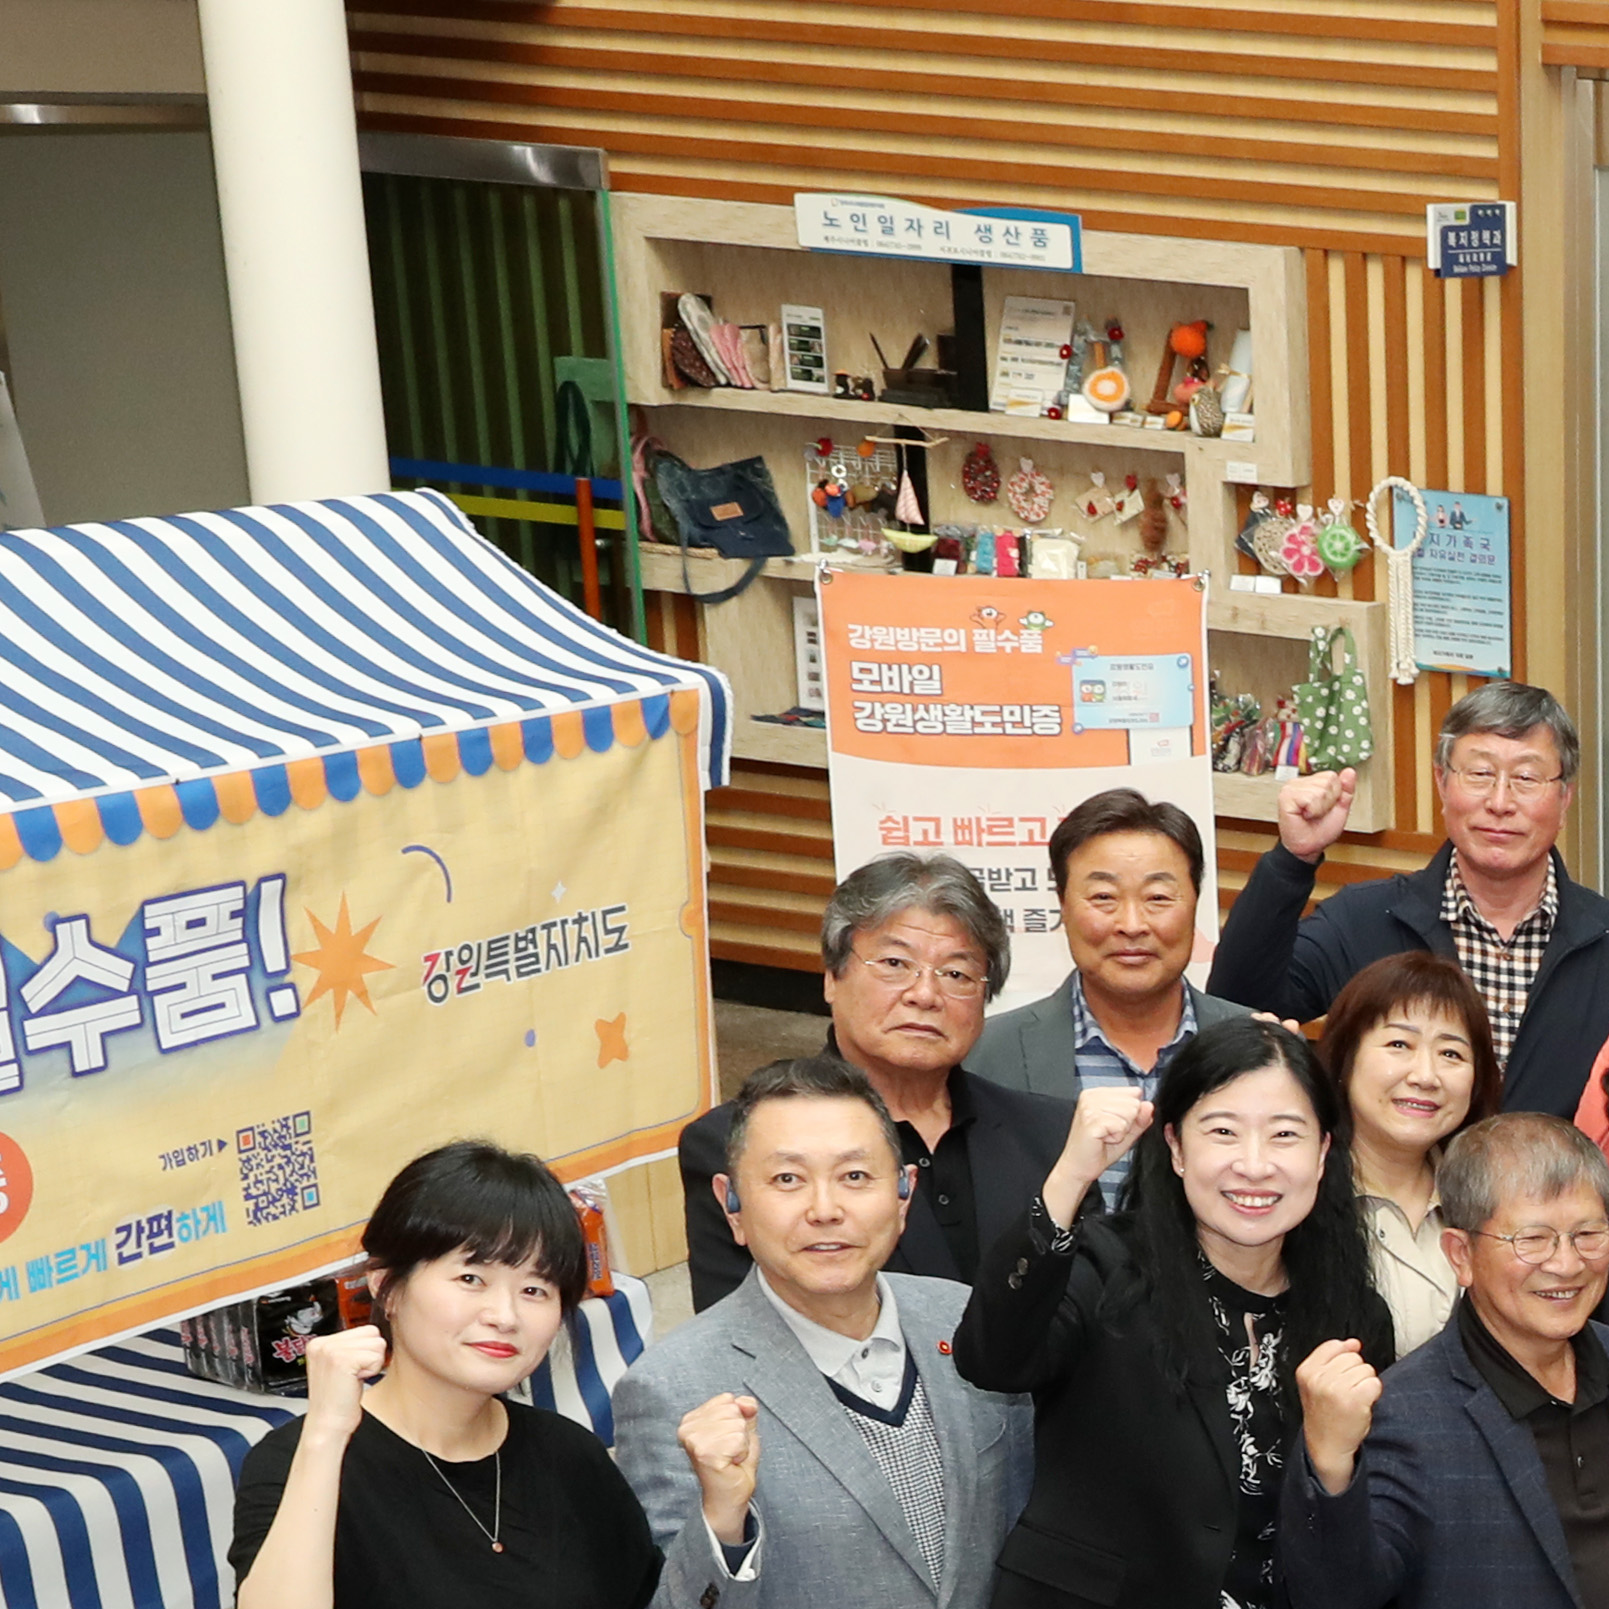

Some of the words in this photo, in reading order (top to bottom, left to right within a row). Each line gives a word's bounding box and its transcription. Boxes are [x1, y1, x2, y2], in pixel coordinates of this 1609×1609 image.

[821, 210, 952, 240] 노인일자리
[974, 223, 1050, 249] 생산품
[847, 624, 967, 653] 강원방문의
[972, 628, 1044, 654] 필수품
[849, 660, 943, 696] 모바일
[852, 700, 1063, 737] 강원생활도민증
[878, 814, 945, 848] 쉽고
[952, 816, 1051, 849] 빠르고
[421, 904, 630, 1004] 강원특별자치도
[158, 1139, 215, 1172] 가입하기
[26, 1238, 108, 1294] 빠르게
[114, 1199, 228, 1266] 간편하게
